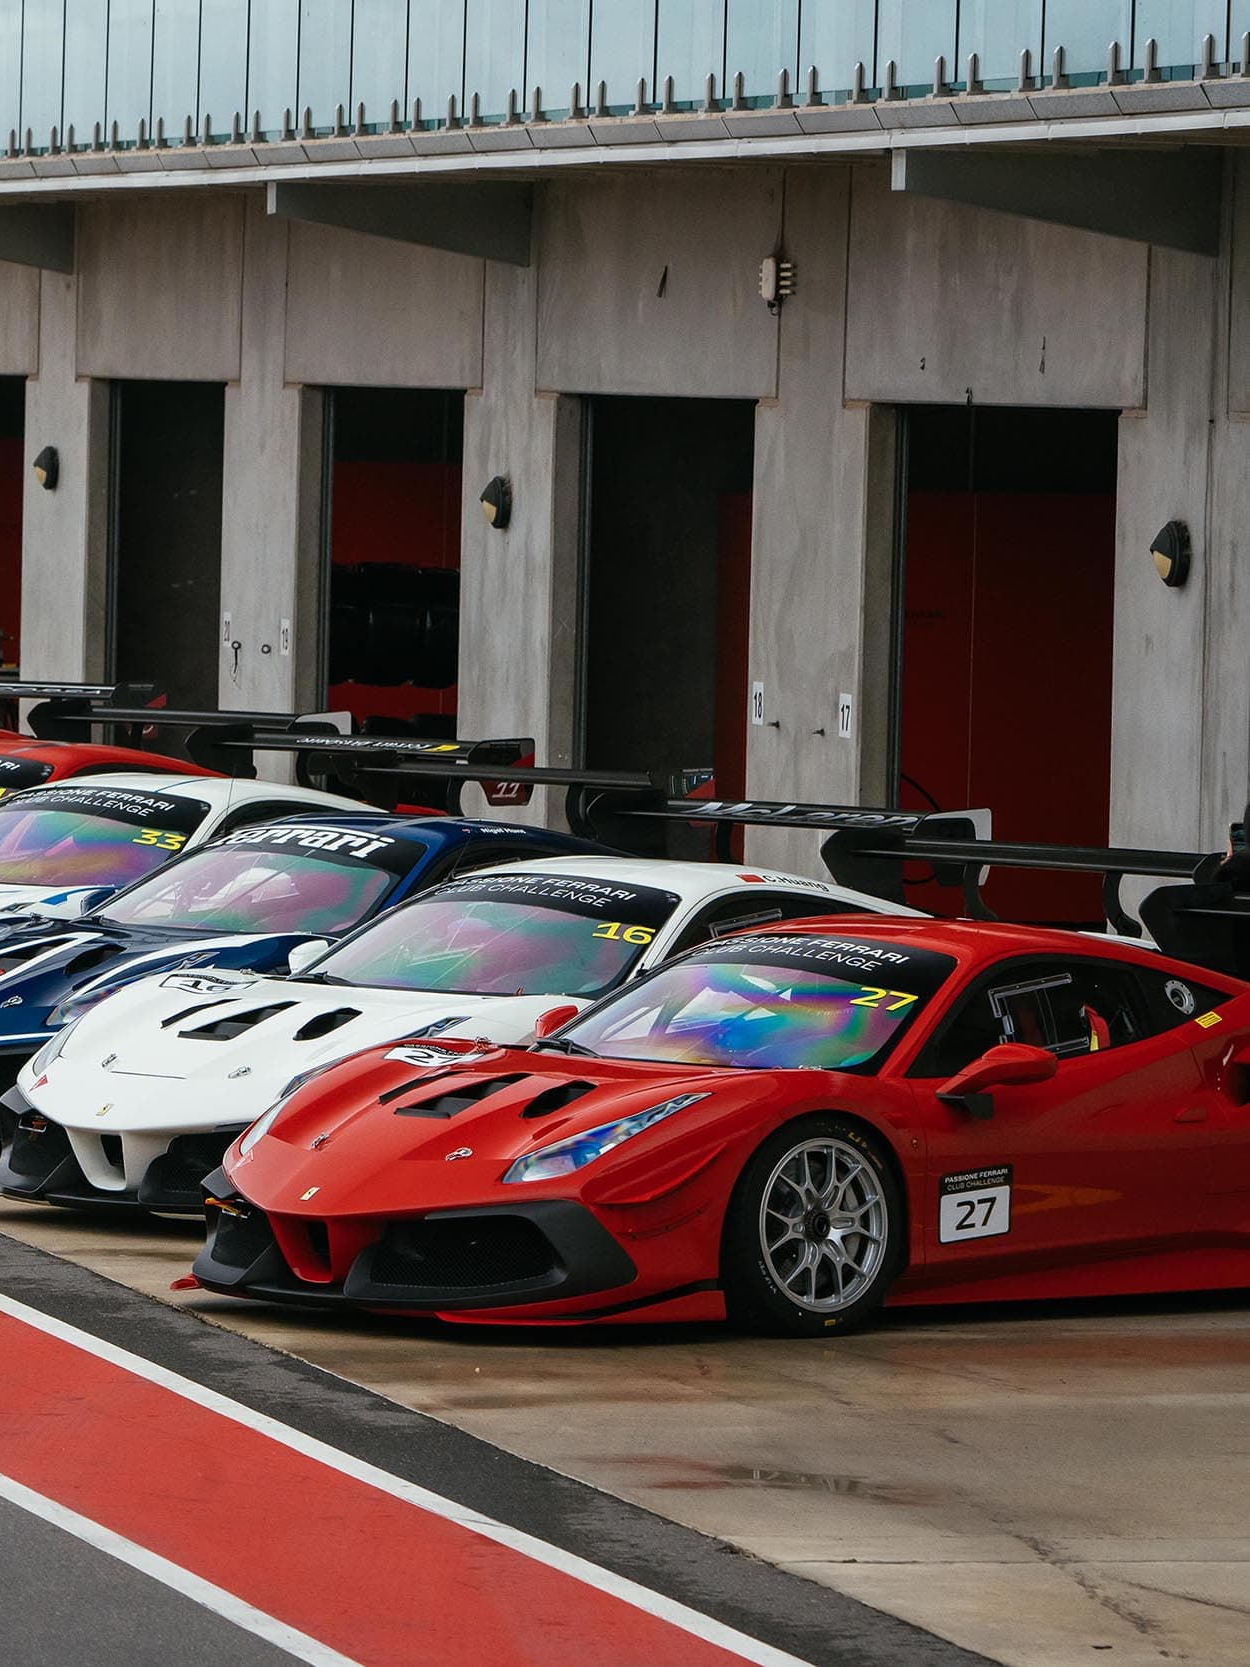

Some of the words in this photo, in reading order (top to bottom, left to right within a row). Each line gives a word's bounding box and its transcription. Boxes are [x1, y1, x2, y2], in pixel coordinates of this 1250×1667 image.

[754, 692, 763, 719] 18
[841, 704, 851, 732] 17
[49, 795, 155, 818] CHALLENGE
[95, 789, 175, 812] FERRARI
[132, 828, 187, 851] 33
[203, 824, 396, 859] Ferrari
[487, 884, 612, 908] CHALLENGE
[541, 878, 638, 901] FERRARI
[591, 922, 656, 945] 16
[748, 945, 883, 972] CHALLENGE
[807, 939, 910, 964] FERRARI
[849, 987, 919, 1012] 27
[945, 1173, 978, 1183] PASSIONE
[979, 1168, 1008, 1179] FERRARI
[947, 1181, 965, 1191] CLUB
[966, 1176, 1005, 1188] CHALLENGE
[955, 1196, 997, 1231] 27
